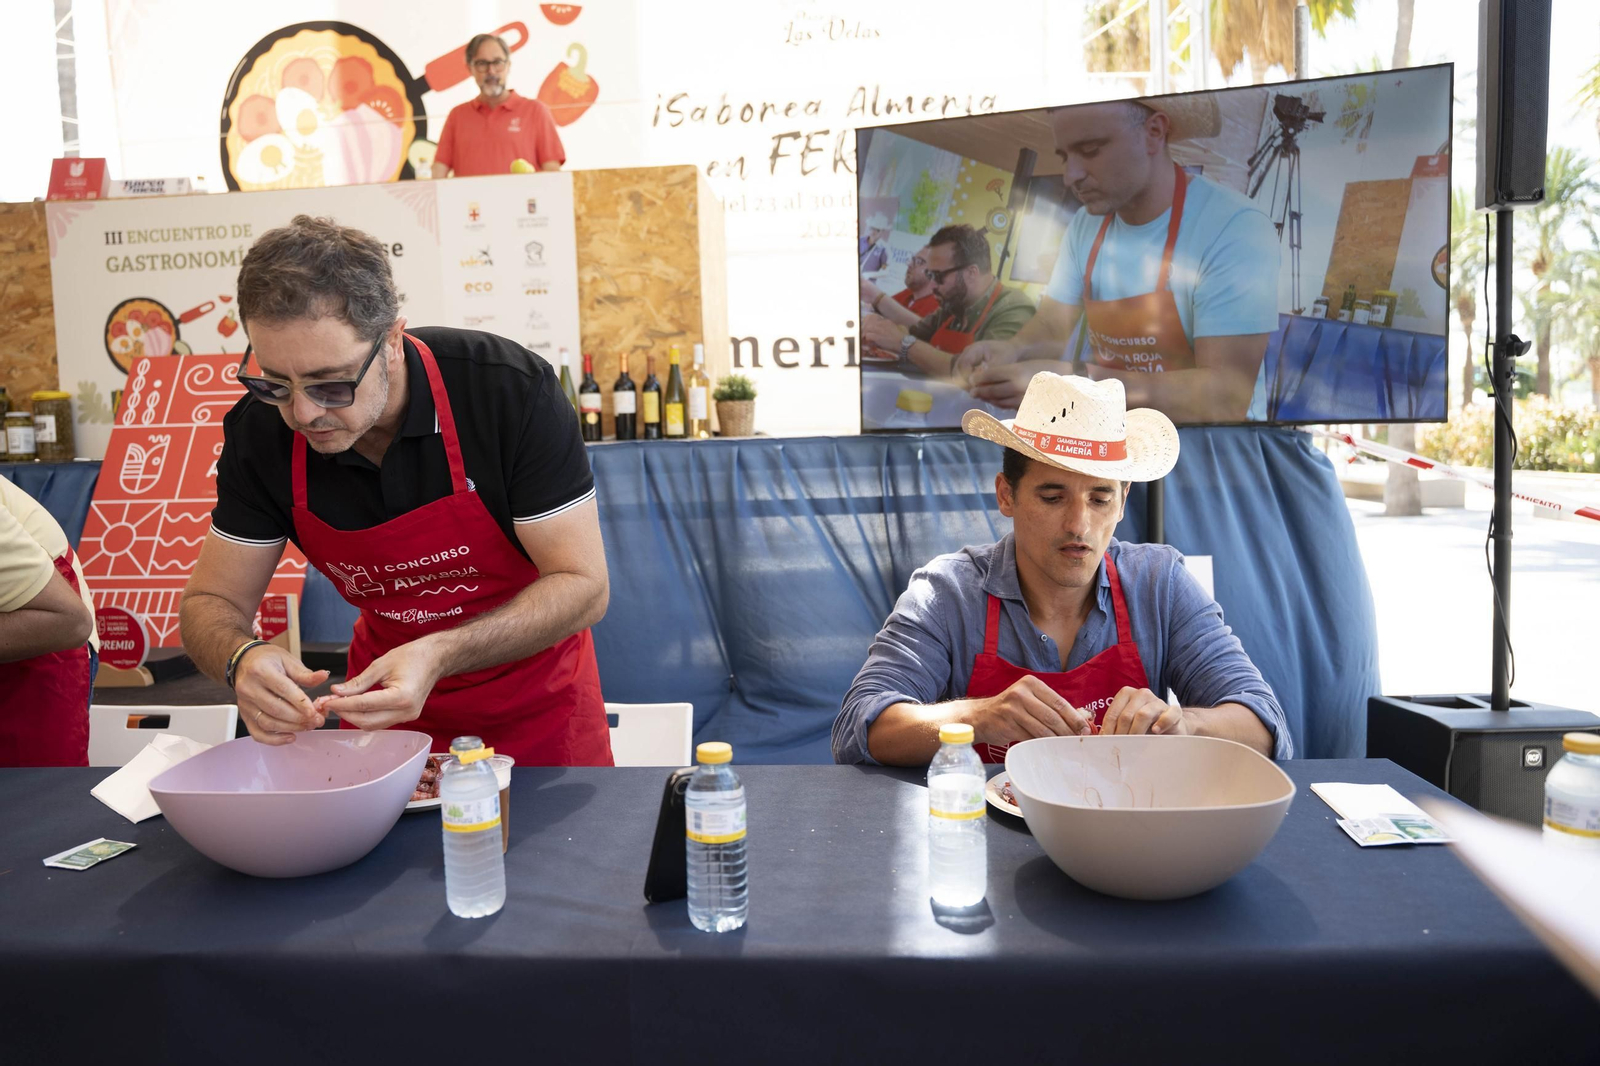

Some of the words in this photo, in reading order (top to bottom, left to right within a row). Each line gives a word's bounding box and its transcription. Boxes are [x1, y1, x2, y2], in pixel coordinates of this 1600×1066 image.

[769, 129, 857, 177] FER
[104, 231, 123, 245] III
[127, 226, 228, 245] ENCUENTRO
[231, 224, 253, 239] DE
[106, 247, 244, 273] GASTRONOMÍ
[464, 281, 493, 293] eco
[1057, 437, 1077, 446] GAMBA
[1054, 444, 1092, 456] ALMERÍA
[384, 545, 470, 572] CONCURSO
[99, 639, 135, 651] PREMIO
